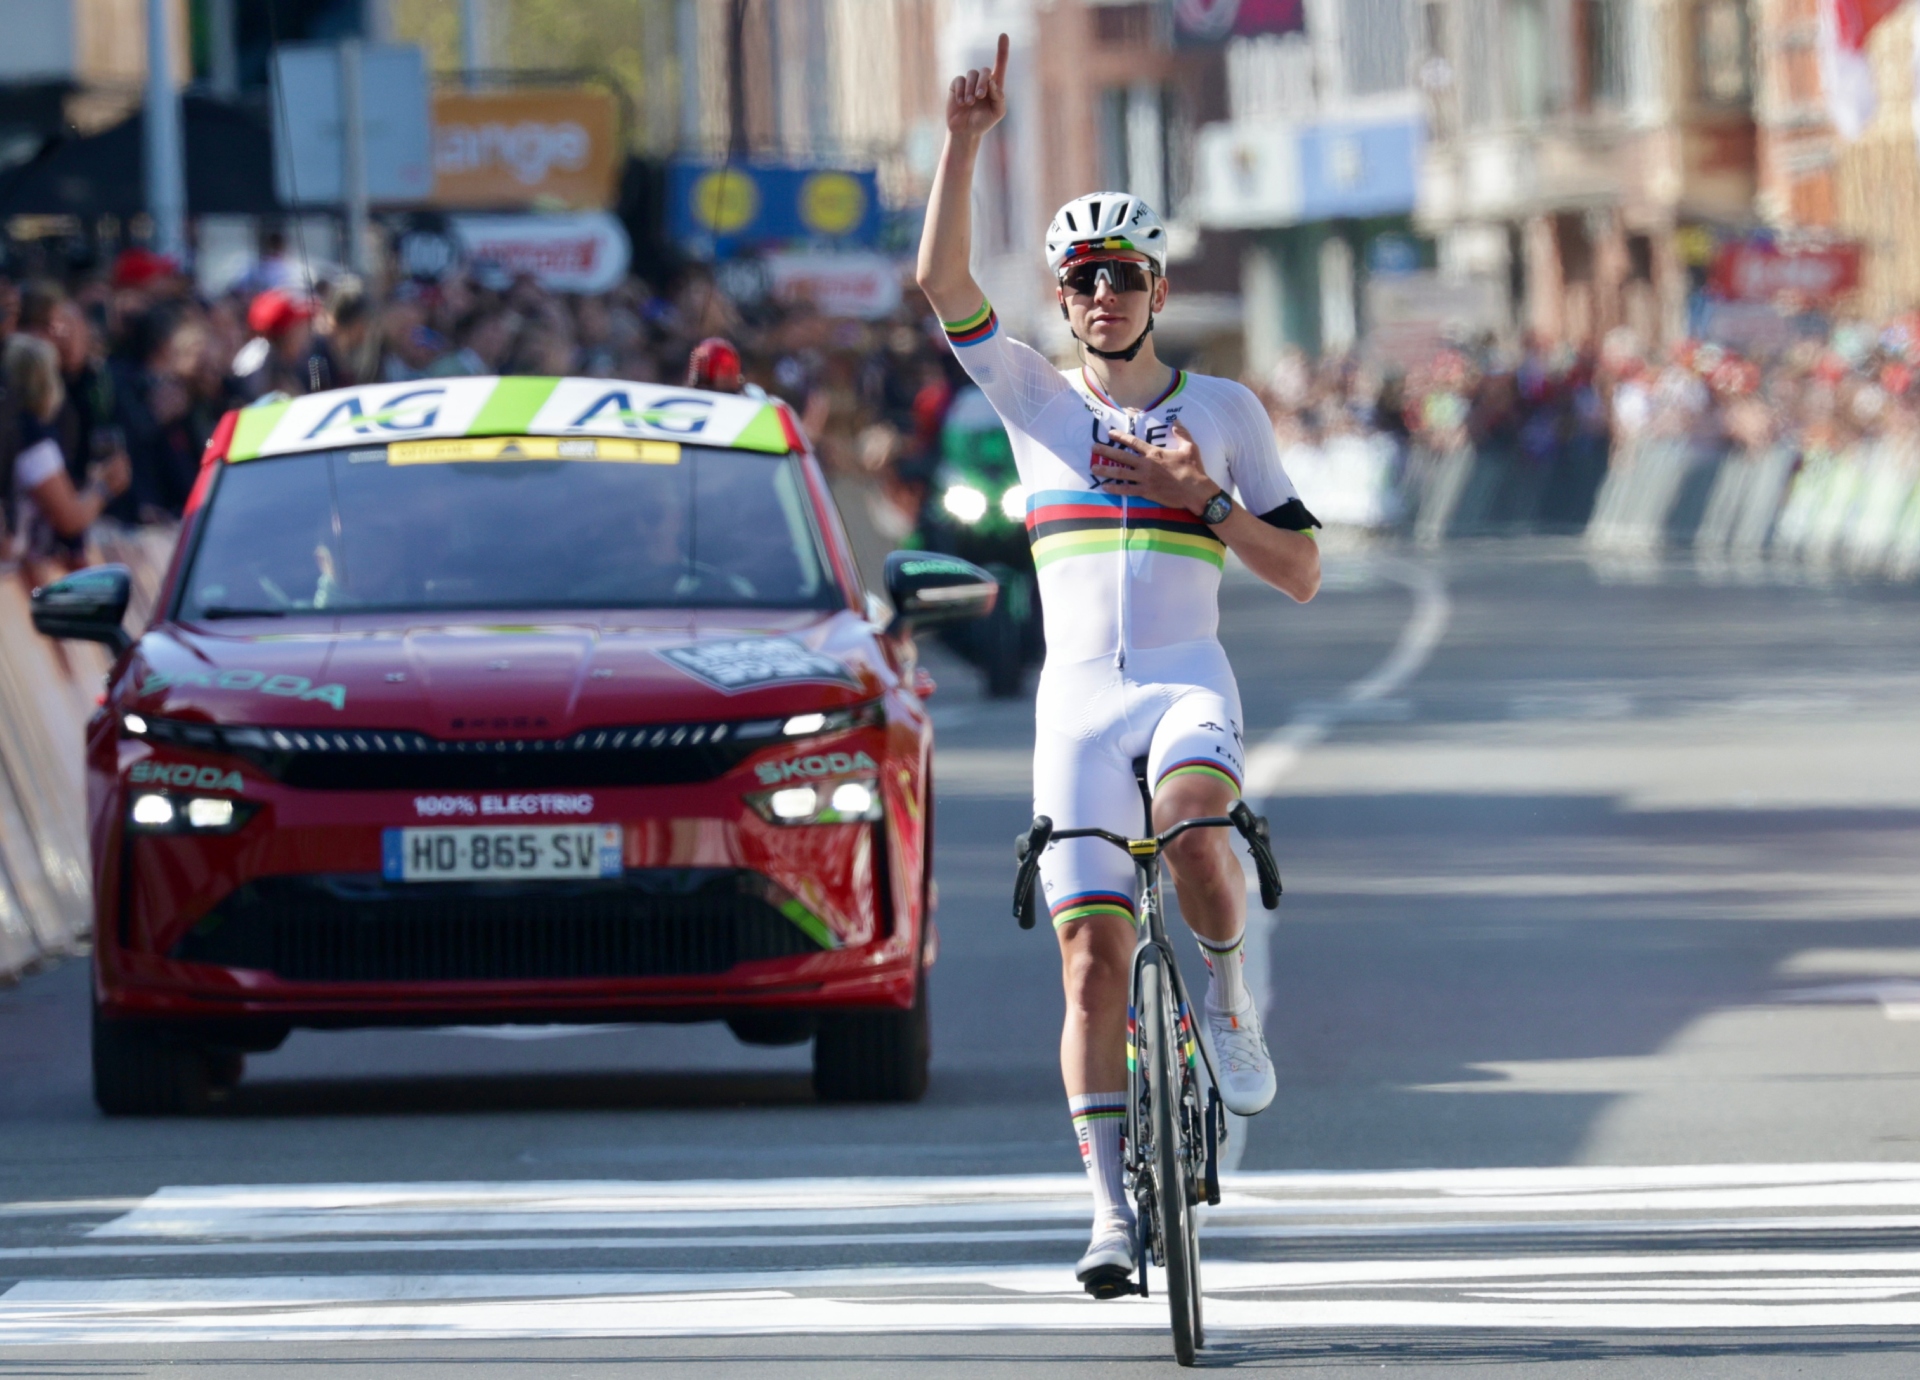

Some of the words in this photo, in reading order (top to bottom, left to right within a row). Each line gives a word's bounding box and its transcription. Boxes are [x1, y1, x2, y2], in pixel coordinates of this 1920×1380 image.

[434, 121, 590, 184] ange
[303, 388, 446, 440] AG
[572, 389, 714, 433] AG
[414, 795, 476, 816] 100%
[480, 794, 595, 815] ELECTRIC
